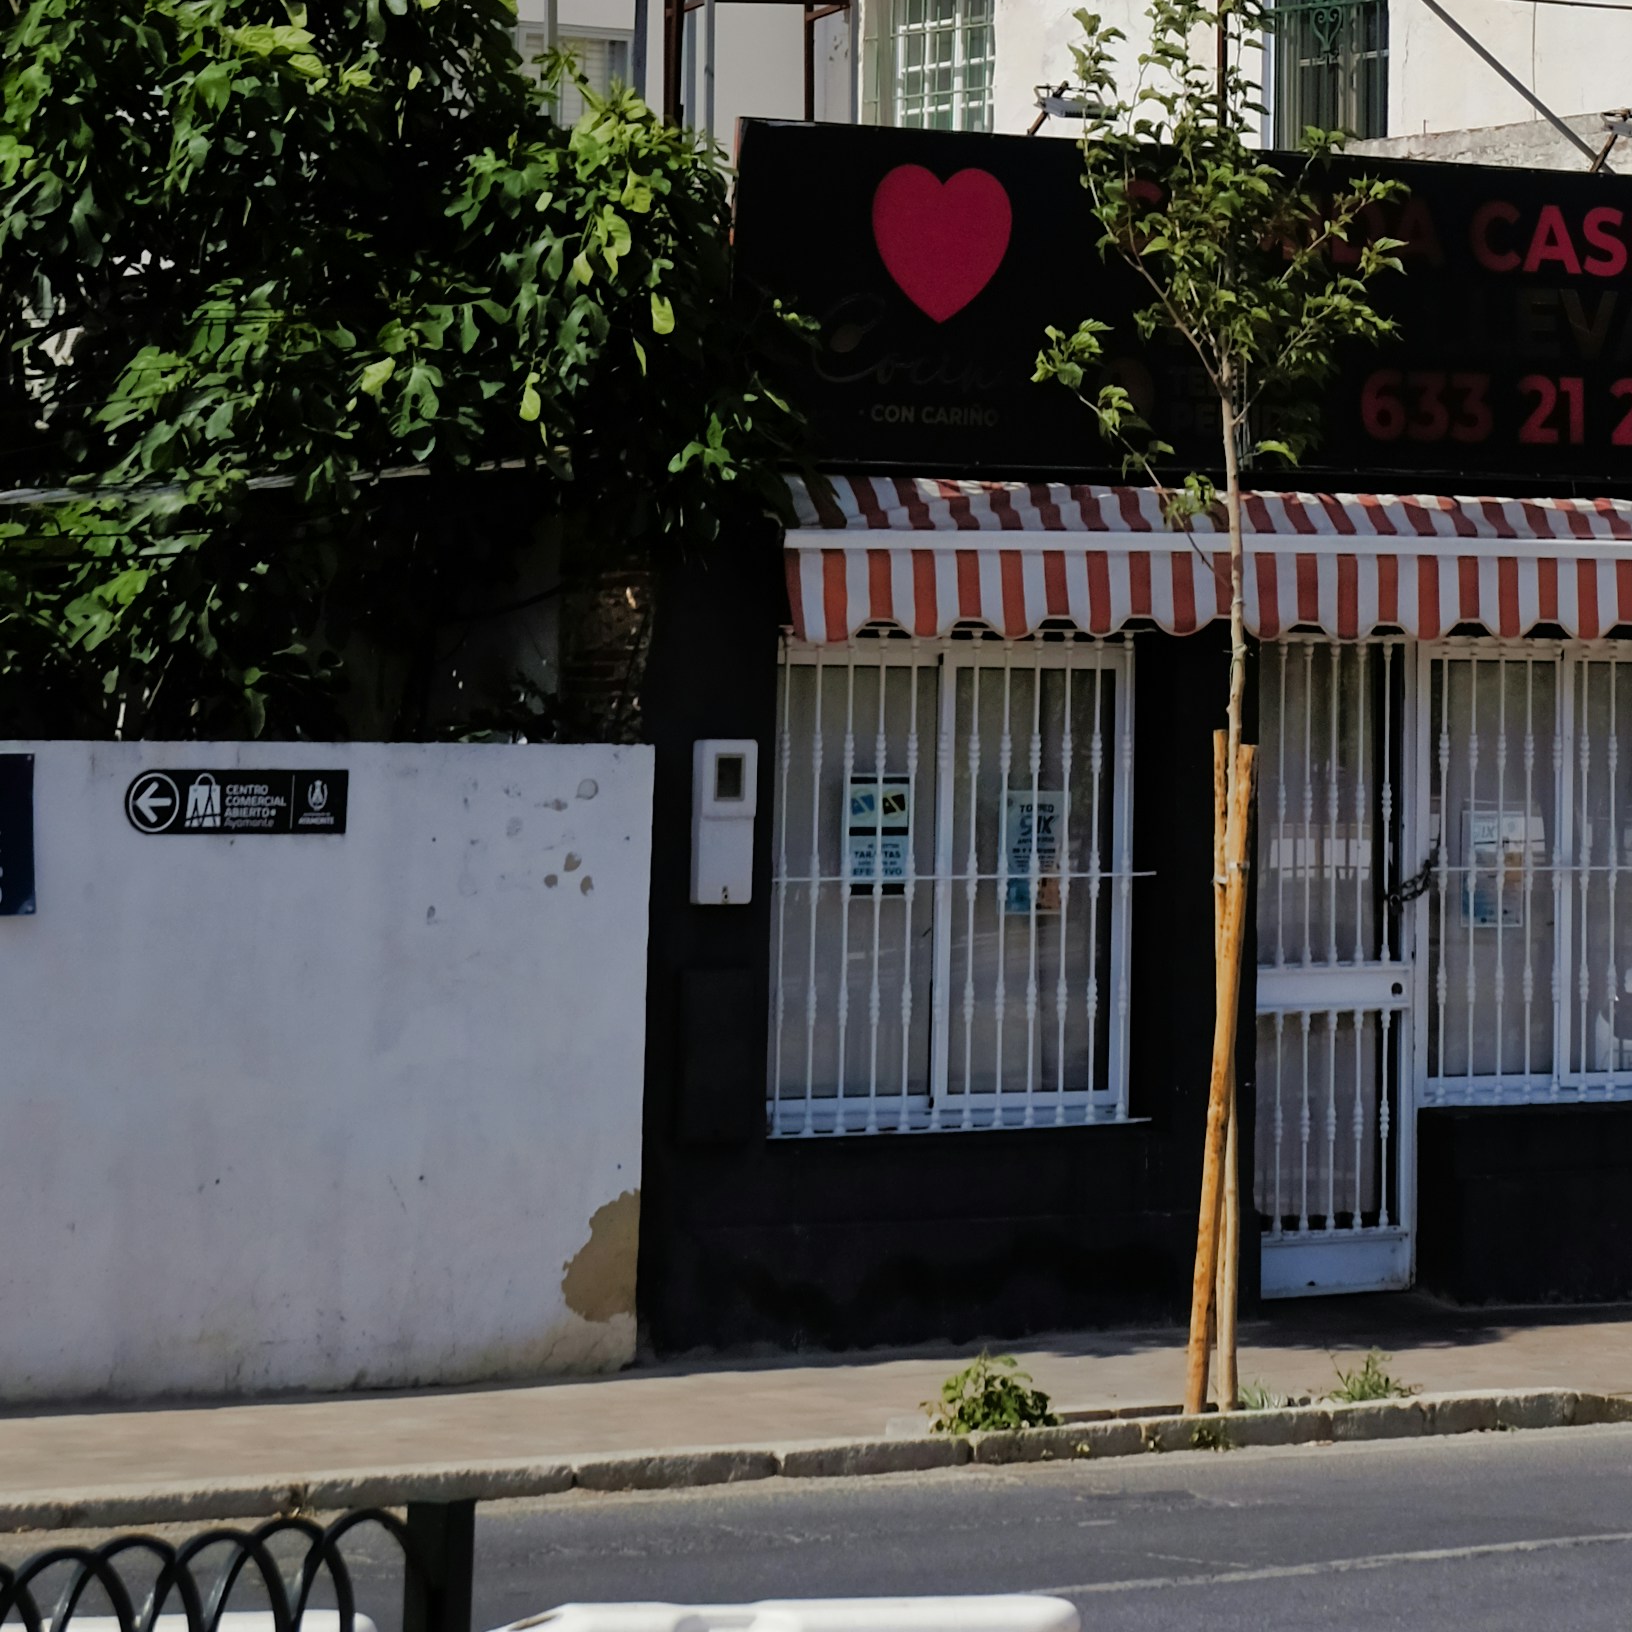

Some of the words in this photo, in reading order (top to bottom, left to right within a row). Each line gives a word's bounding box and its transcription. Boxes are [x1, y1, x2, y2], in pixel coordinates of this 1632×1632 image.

[1361, 368, 1495, 446] 633
[1519, 374, 1586, 447] 21
[870, 404, 916, 425] CON
[921, 402, 1001, 428] CARIÑO
[225, 784, 269, 795] CENTRO
[225, 796, 287, 807] COMERCIAL
[223, 807, 270, 818] ABIERTO
[223, 817, 275, 830] Ayamonte
